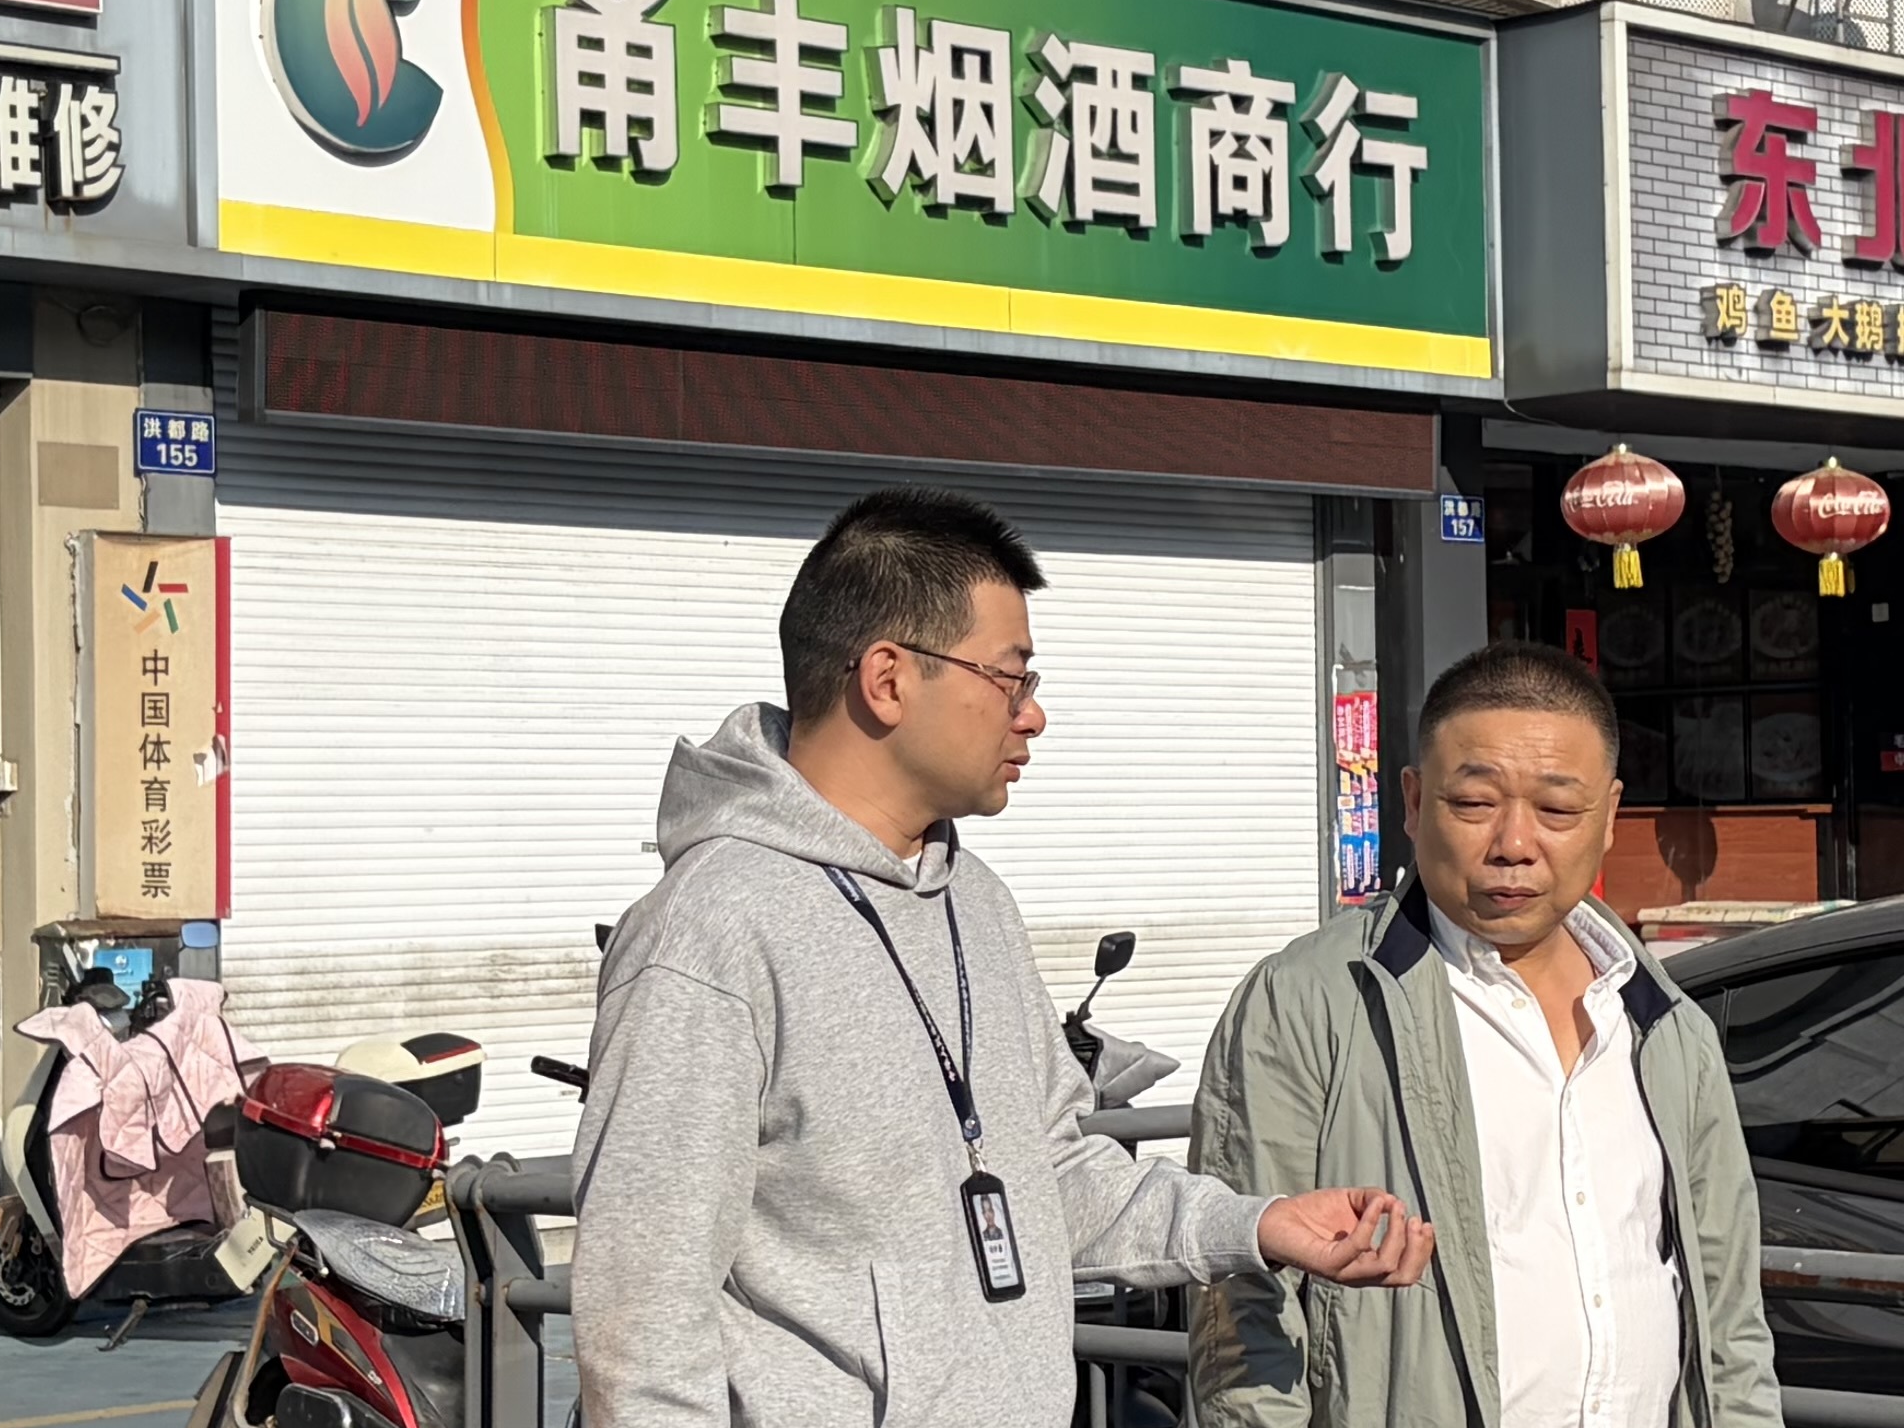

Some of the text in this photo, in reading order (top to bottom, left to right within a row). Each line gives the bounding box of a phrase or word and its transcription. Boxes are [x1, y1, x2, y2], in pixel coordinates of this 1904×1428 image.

[143, 416, 211, 445] 洪都路
[155, 444, 199, 468] 155
[1451, 518, 1475, 537] 157
[139, 648, 172, 898] 中国体育彩票
